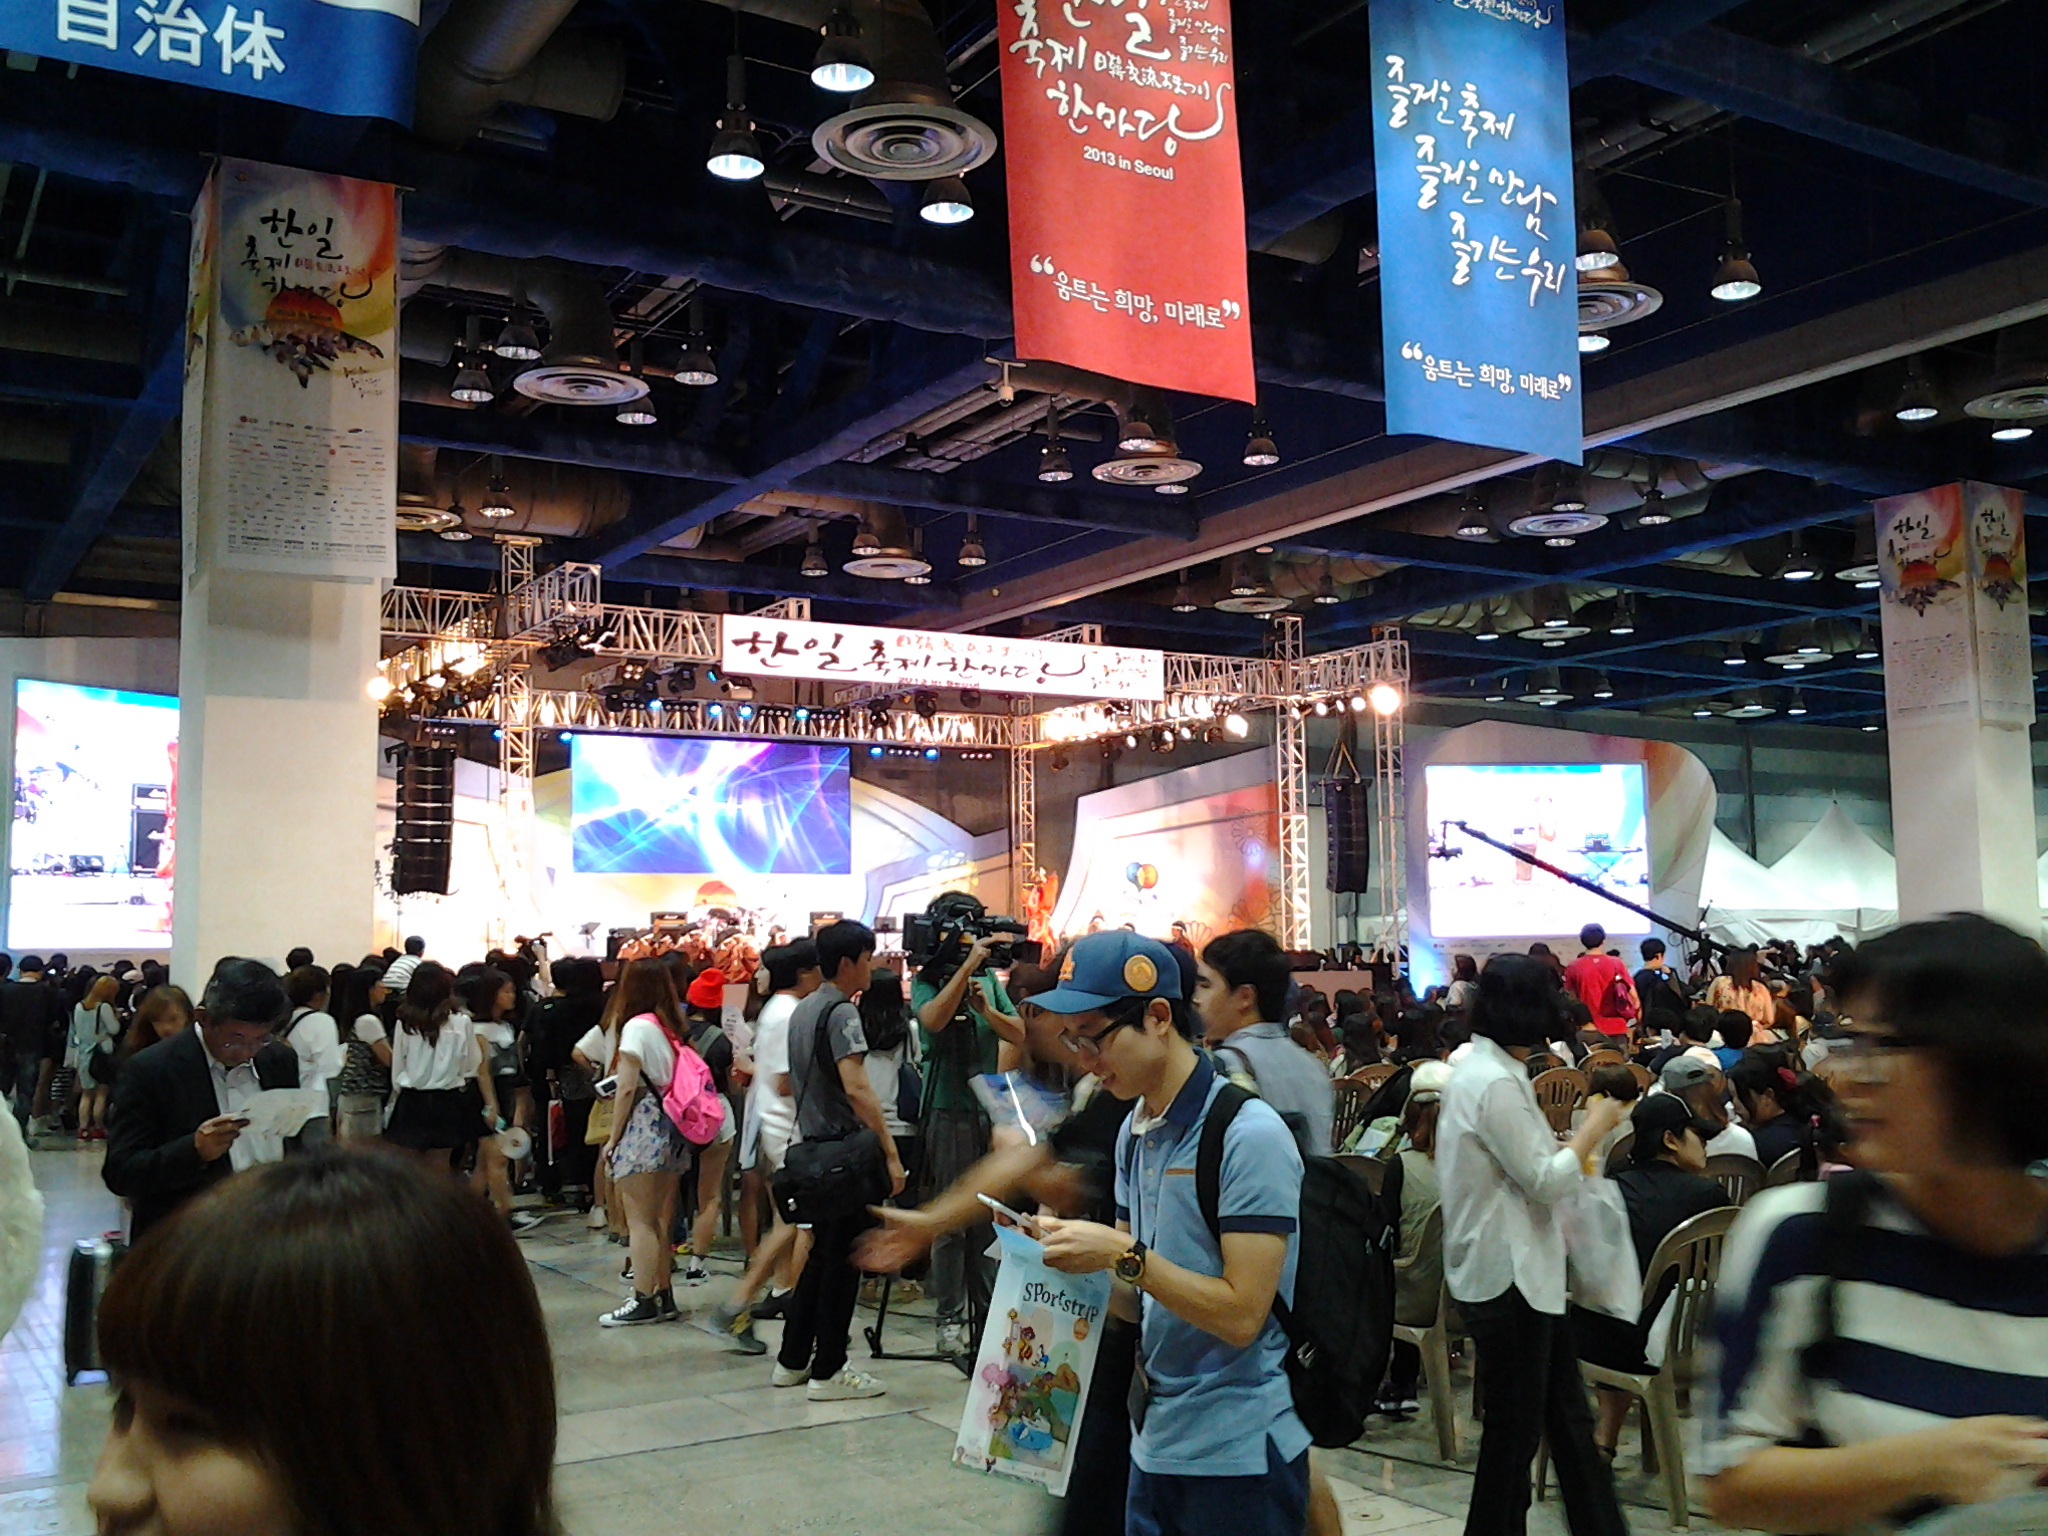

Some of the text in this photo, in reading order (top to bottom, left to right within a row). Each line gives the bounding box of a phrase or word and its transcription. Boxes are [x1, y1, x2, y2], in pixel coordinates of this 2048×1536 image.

[57, 0, 286, 80] 自治体
[1046, 79, 1232, 156] 한마당
[1385, 55, 1516, 149] 즐거운 축제
[1083, 145, 1175, 181] 2013 in Seoul
[1415, 134, 1558, 241] 즐거운 만남
[260, 208, 345, 260] 한일
[1520, 247, 1567, 308] 우리
[1114, 289, 1159, 324] 희망,
[1479, 364, 1516, 395] 희망,
[731, 630, 858, 672] 한일
[863, 639, 932, 676] 축제
[936, 651, 1090, 684] 한마당
